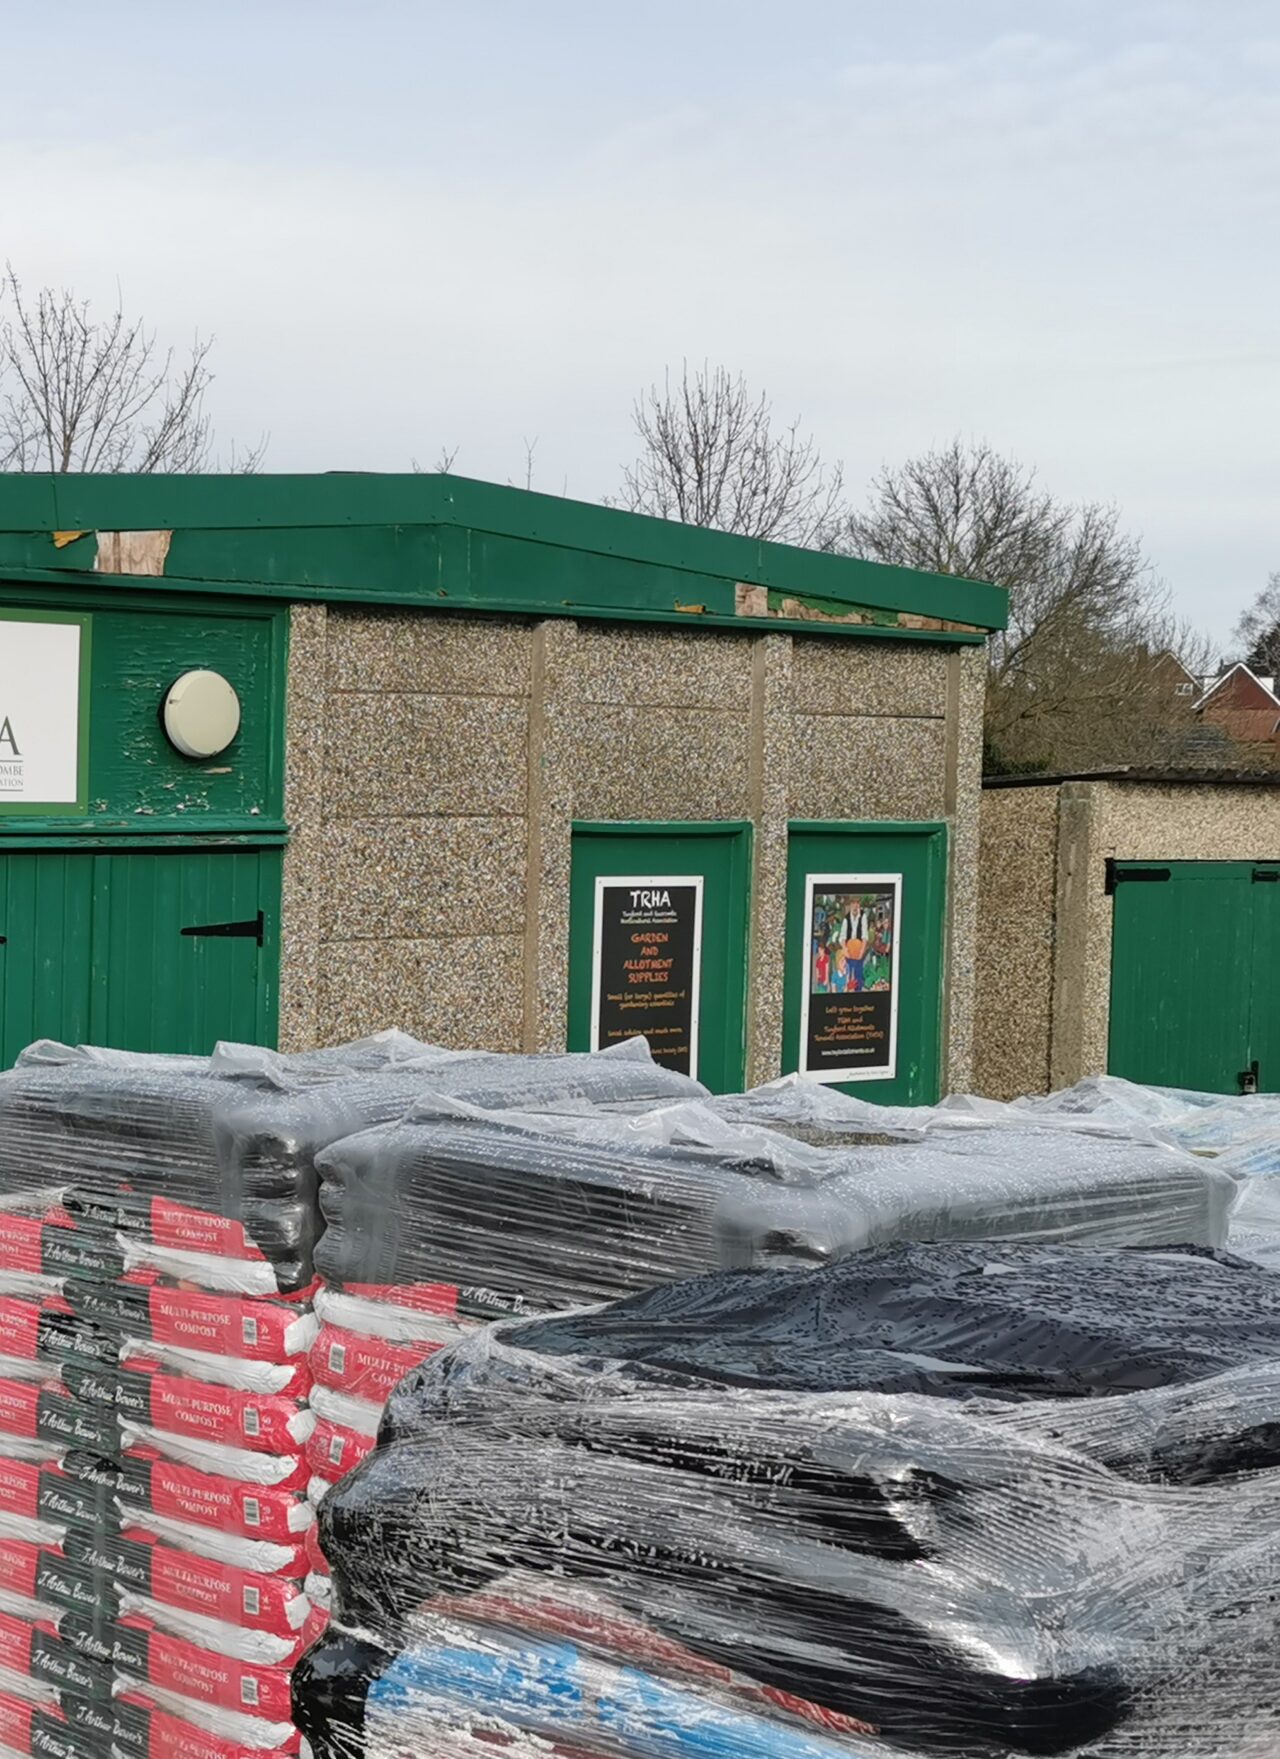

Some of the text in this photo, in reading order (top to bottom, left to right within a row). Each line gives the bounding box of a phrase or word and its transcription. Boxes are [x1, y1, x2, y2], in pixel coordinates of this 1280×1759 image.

[630, 890, 671, 908] TRHA
[641, 946, 659, 956] AND
[623, 958, 673, 970] ALLOTMENT
[628, 972, 669, 983] SUPPLIES
[174, 1320, 218, 1338] COMPOST
